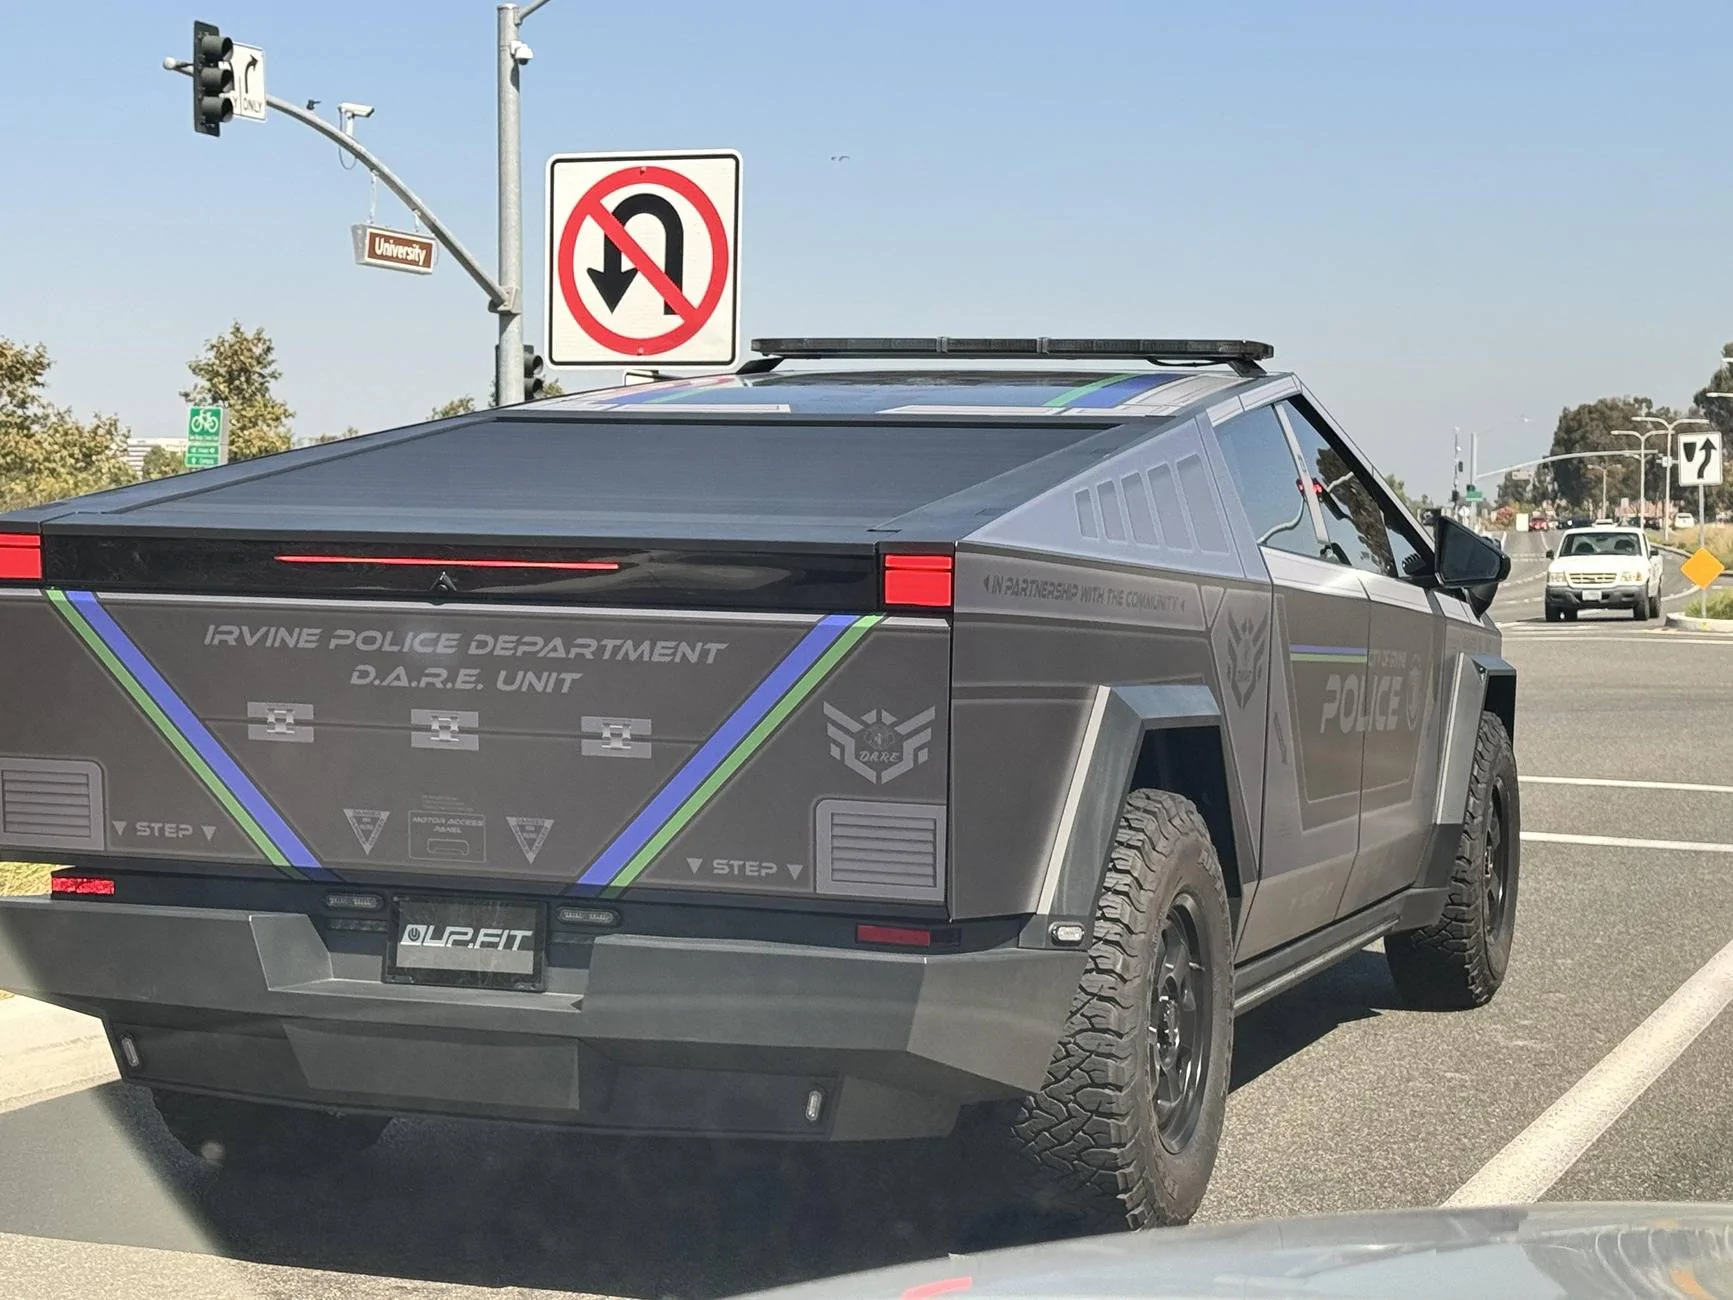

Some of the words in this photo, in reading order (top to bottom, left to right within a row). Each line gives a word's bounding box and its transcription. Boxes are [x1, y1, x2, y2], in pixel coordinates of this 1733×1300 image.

[243, 97, 263, 113] ONLY
[374, 236, 427, 266] University
[991, 575, 1004, 595] IN
[1004, 576, 1079, 601] PARTNERSHIP
[1080, 584, 1105, 605] WITH
[1106, 587, 1125, 608] THE
[1126, 590, 1180, 612] COMMUNITY
[204, 624, 323, 649] IRVINE
[329, 628, 463, 654] POLICE
[467, 633, 730, 664] DEPARTMENT
[350, 664, 484, 690] D.A.R.E.
[496, 669, 584, 693] UNIT
[1320, 672, 1403, 734] POLICE
[859, 750, 900, 763] DARE
[135, 821, 193, 838] STEP
[412, 816, 446, 825] MOTOR
[447, 818, 485, 827] ACCESS
[712, 859, 777, 877] STEP
